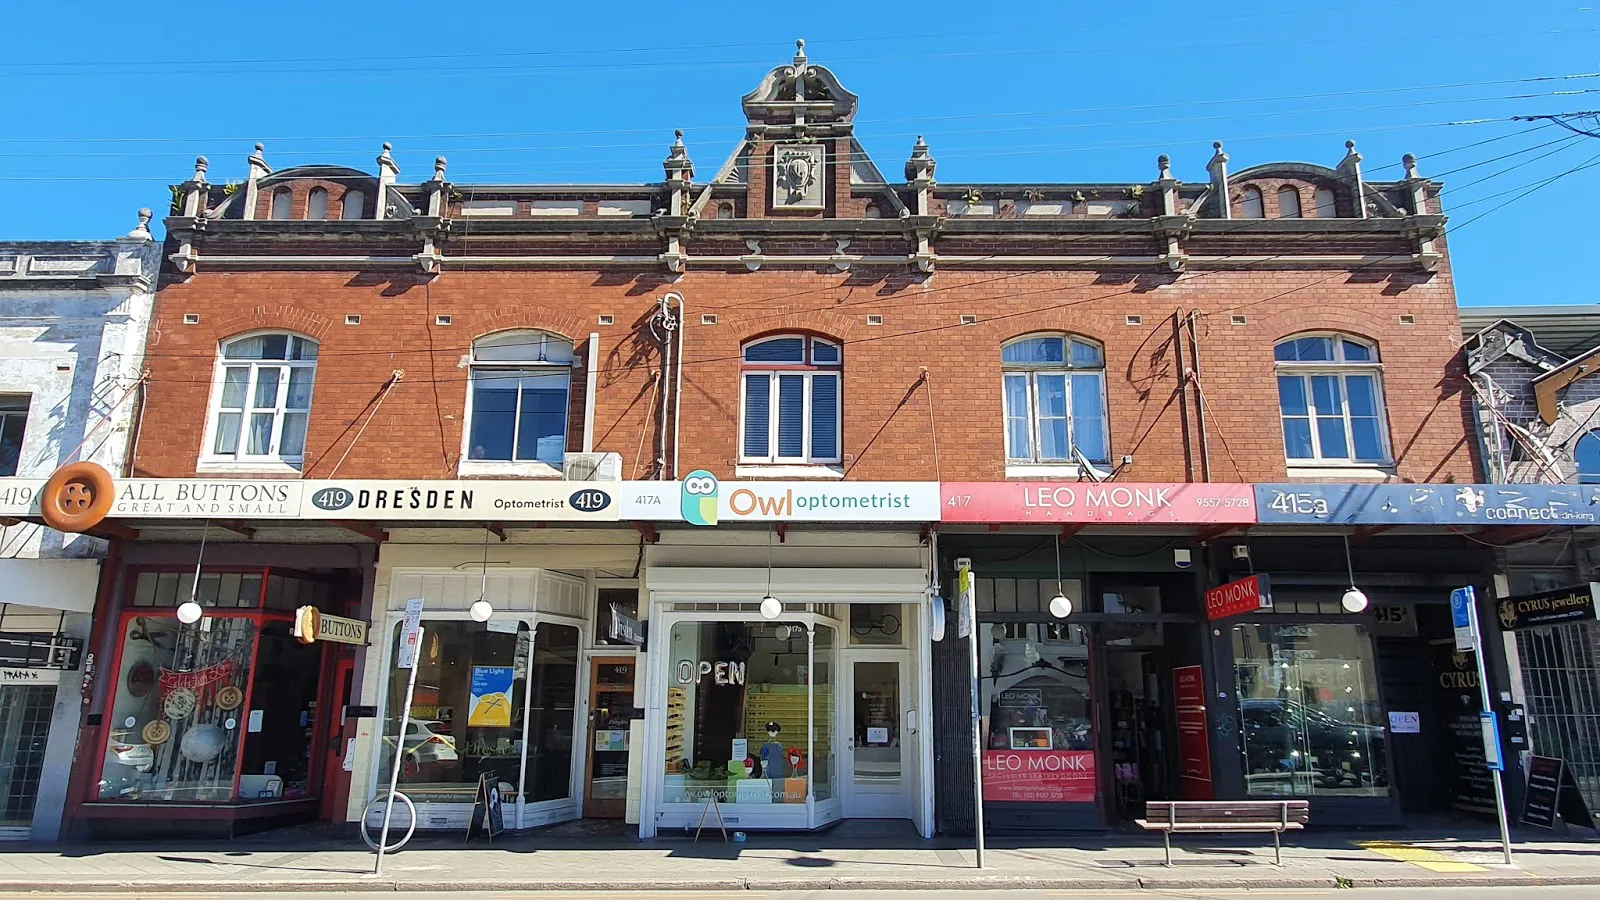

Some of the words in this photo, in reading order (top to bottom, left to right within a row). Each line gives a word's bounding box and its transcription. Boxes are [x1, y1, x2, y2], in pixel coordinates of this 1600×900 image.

[120, 483, 165, 501] ALL
[176, 484, 289, 502] BUTTONS
[318, 490, 347, 507] 419
[358, 489, 474, 510] DRESDEN
[575, 492, 604, 509] 419
[635, 495, 661, 505] 417A
[1024, 487, 1076, 508] LEO
[1085, 487, 1173, 508] MONK
[117, 502, 175, 513] GREAT
[182, 503, 220, 513] AND
[228, 503, 287, 514] SMALL
[494, 498, 564, 511] Optometrist
[729, 488, 793, 516] Owl
[796, 493, 911, 511] optometrist
[947, 495, 971, 508] 417
[1196, 496, 1221, 508] 9557
[1224, 496, 1250, 508] 5728
[1271, 493, 1328, 513] 415a
[1485, 507, 1558, 520] connect
[1206, 590, 1224, 609] LEO
[1225, 580, 1256, 604] MONK
[1518, 598, 1550, 613] CYRUS
[1551, 593, 1591, 611] jewellery
[321, 619, 363, 639] BUTTONS
[614, 666, 628, 675] 419
[677, 659, 746, 686] OPEN
[1440, 672, 1480, 689] CYRUS
[1001, 692, 1015, 700] LEO
[1016, 692, 1040, 700] MONK
[1390, 715, 1417, 723] OPEN
[987, 755, 1022, 771] LEO
[1028, 755, 1086, 771] MONK
